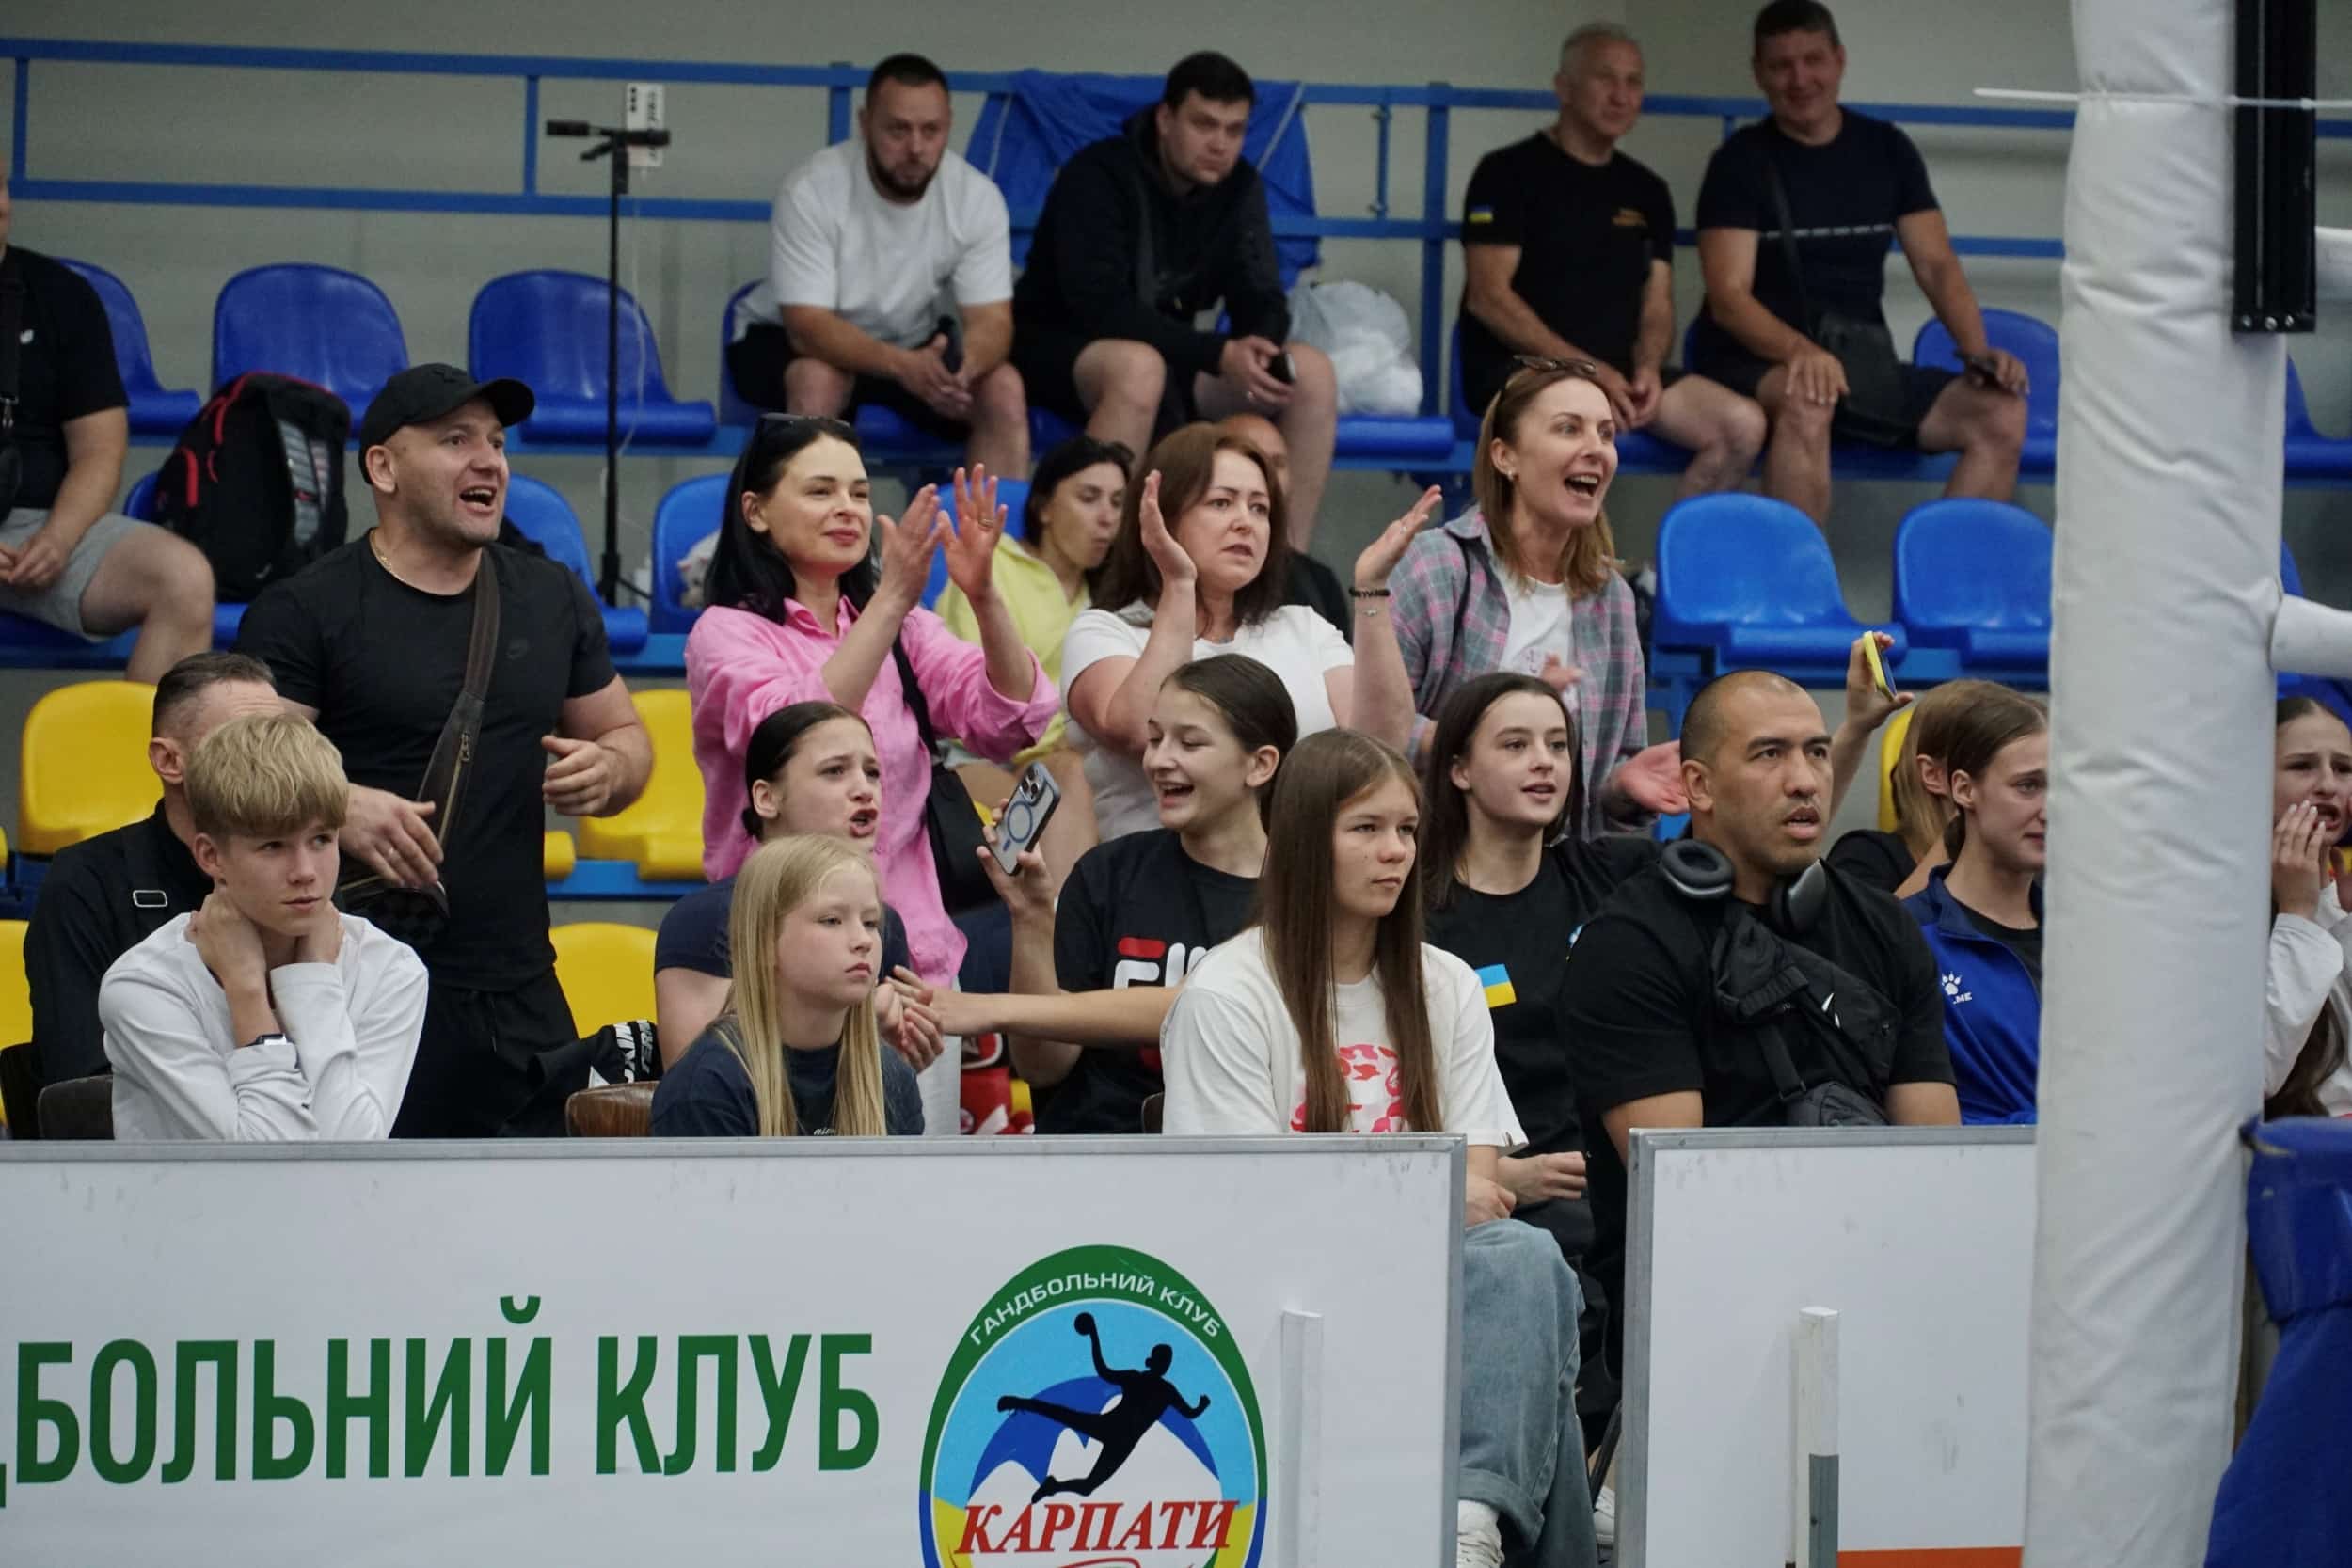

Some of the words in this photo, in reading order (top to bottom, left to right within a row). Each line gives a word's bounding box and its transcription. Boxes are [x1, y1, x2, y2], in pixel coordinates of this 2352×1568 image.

[970, 1272, 1156, 1346] ГАНДБОЛЬНИЙ
[1159, 1285, 1222, 1338] КЛУБ
[0, 1295, 552, 1509] БОЛЬНИЙ
[596, 1332, 881, 1476] КЛУБ
[953, 1499, 1241, 1555] КАРПАТИ
